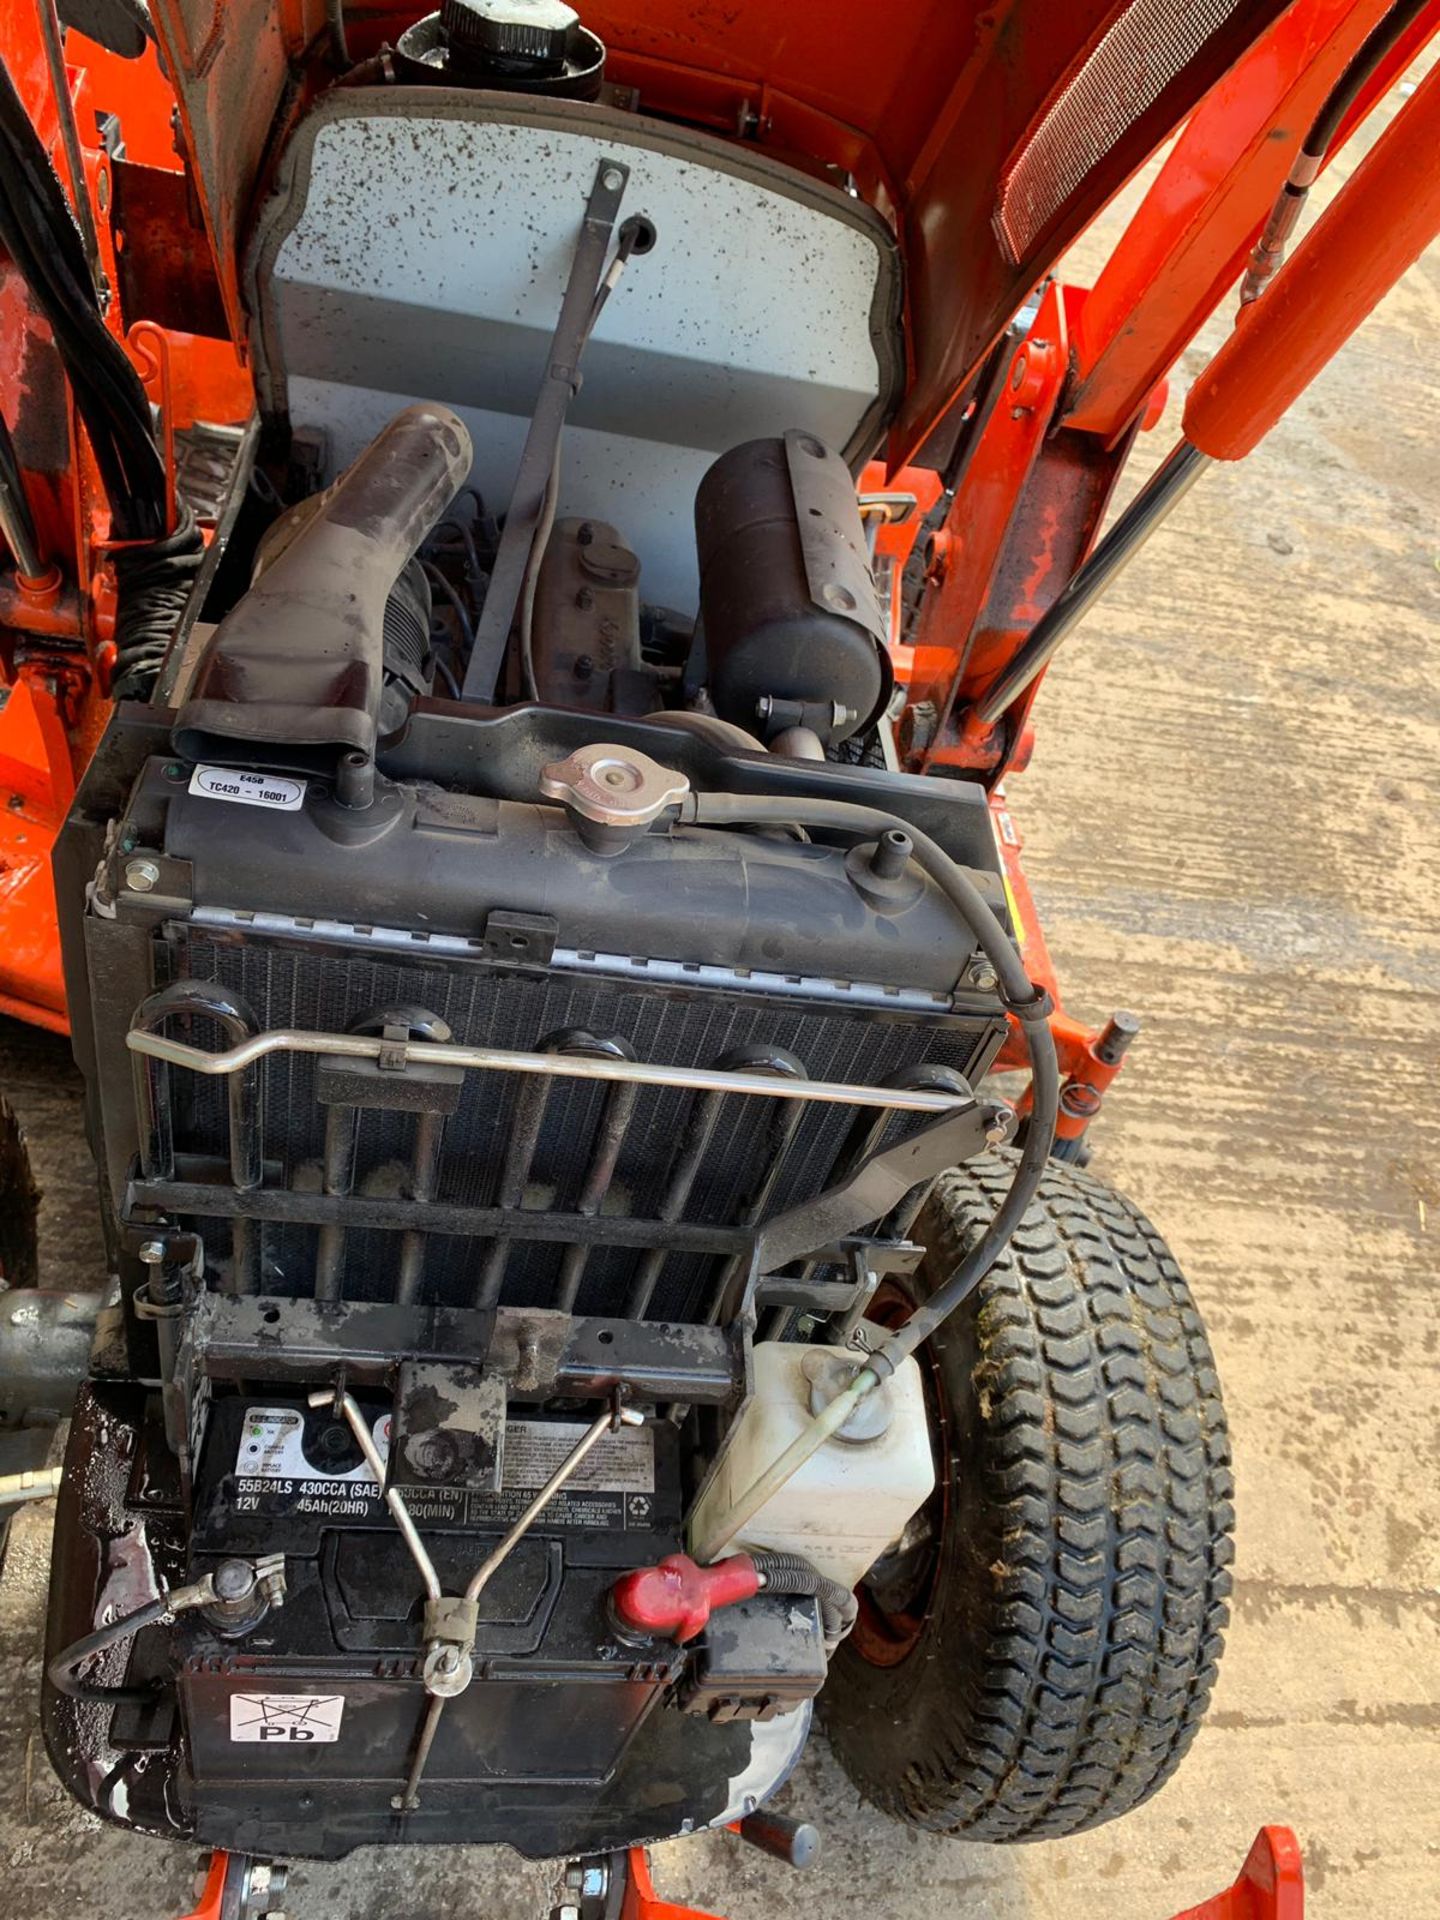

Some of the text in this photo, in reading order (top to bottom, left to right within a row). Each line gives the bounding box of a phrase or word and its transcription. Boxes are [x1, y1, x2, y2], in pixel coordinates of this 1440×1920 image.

[209, 782, 240, 795] TC420
[258, 790, 287, 802] 16001
[238, 1479, 293, 1494] 55B24LS
[299, 1482, 347, 1496] 430CCA
[350, 1484, 382, 1500] (SAE)
[236, 1497, 259, 1510] 12V
[297, 1500, 369, 1517] 45Ah(20HR)
[260, 1726, 315, 1741] Pb
